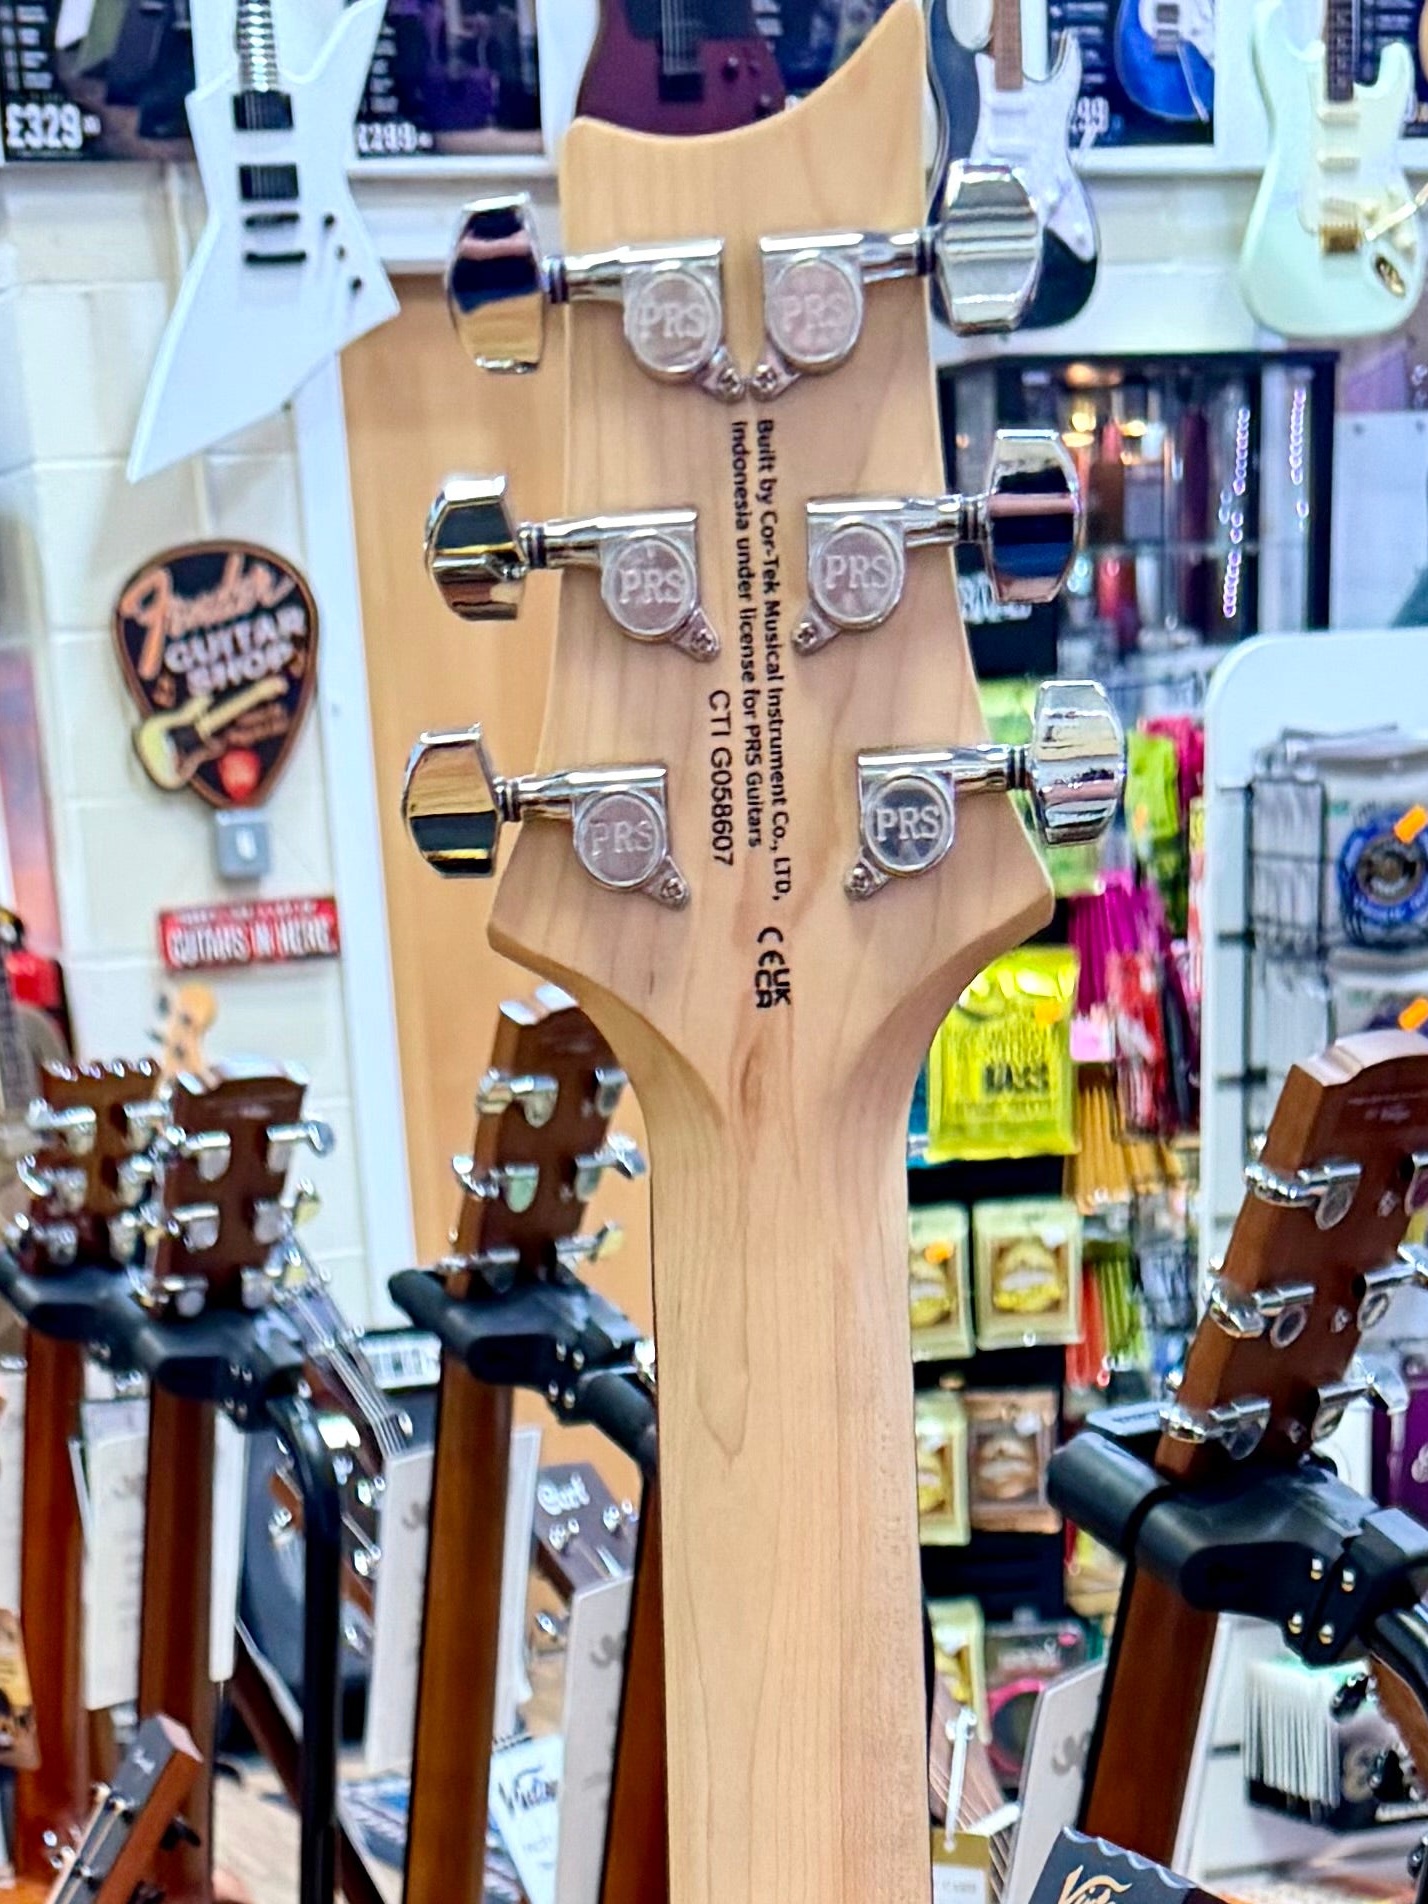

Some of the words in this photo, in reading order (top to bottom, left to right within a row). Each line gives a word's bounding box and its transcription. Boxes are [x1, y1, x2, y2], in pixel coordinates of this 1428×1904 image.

[639, 303, 706, 340] PRS
[785, 293, 848, 335] PRS
[757, 419, 777, 473] Built
[732, 421, 753, 531] Indonesia
[755, 478, 778, 504] by
[735, 537, 756, 602] under
[760, 511, 780, 595] Cor-Tek
[825, 554, 891, 590] PRS
[619, 569, 685, 605] PRS
[165, 603, 306, 672] GUITAR
[739, 607, 759, 683] license
[764, 600, 785, 681] Musical
[742, 688, 761, 722] for
[744, 724, 762, 767] PRS
[766, 687, 787, 806] Instrument
[710, 746, 734, 867] G058607
[746, 771, 764, 849] Guitars
[876, 805, 941, 842] PRS
[588, 820, 654, 857] PRS
